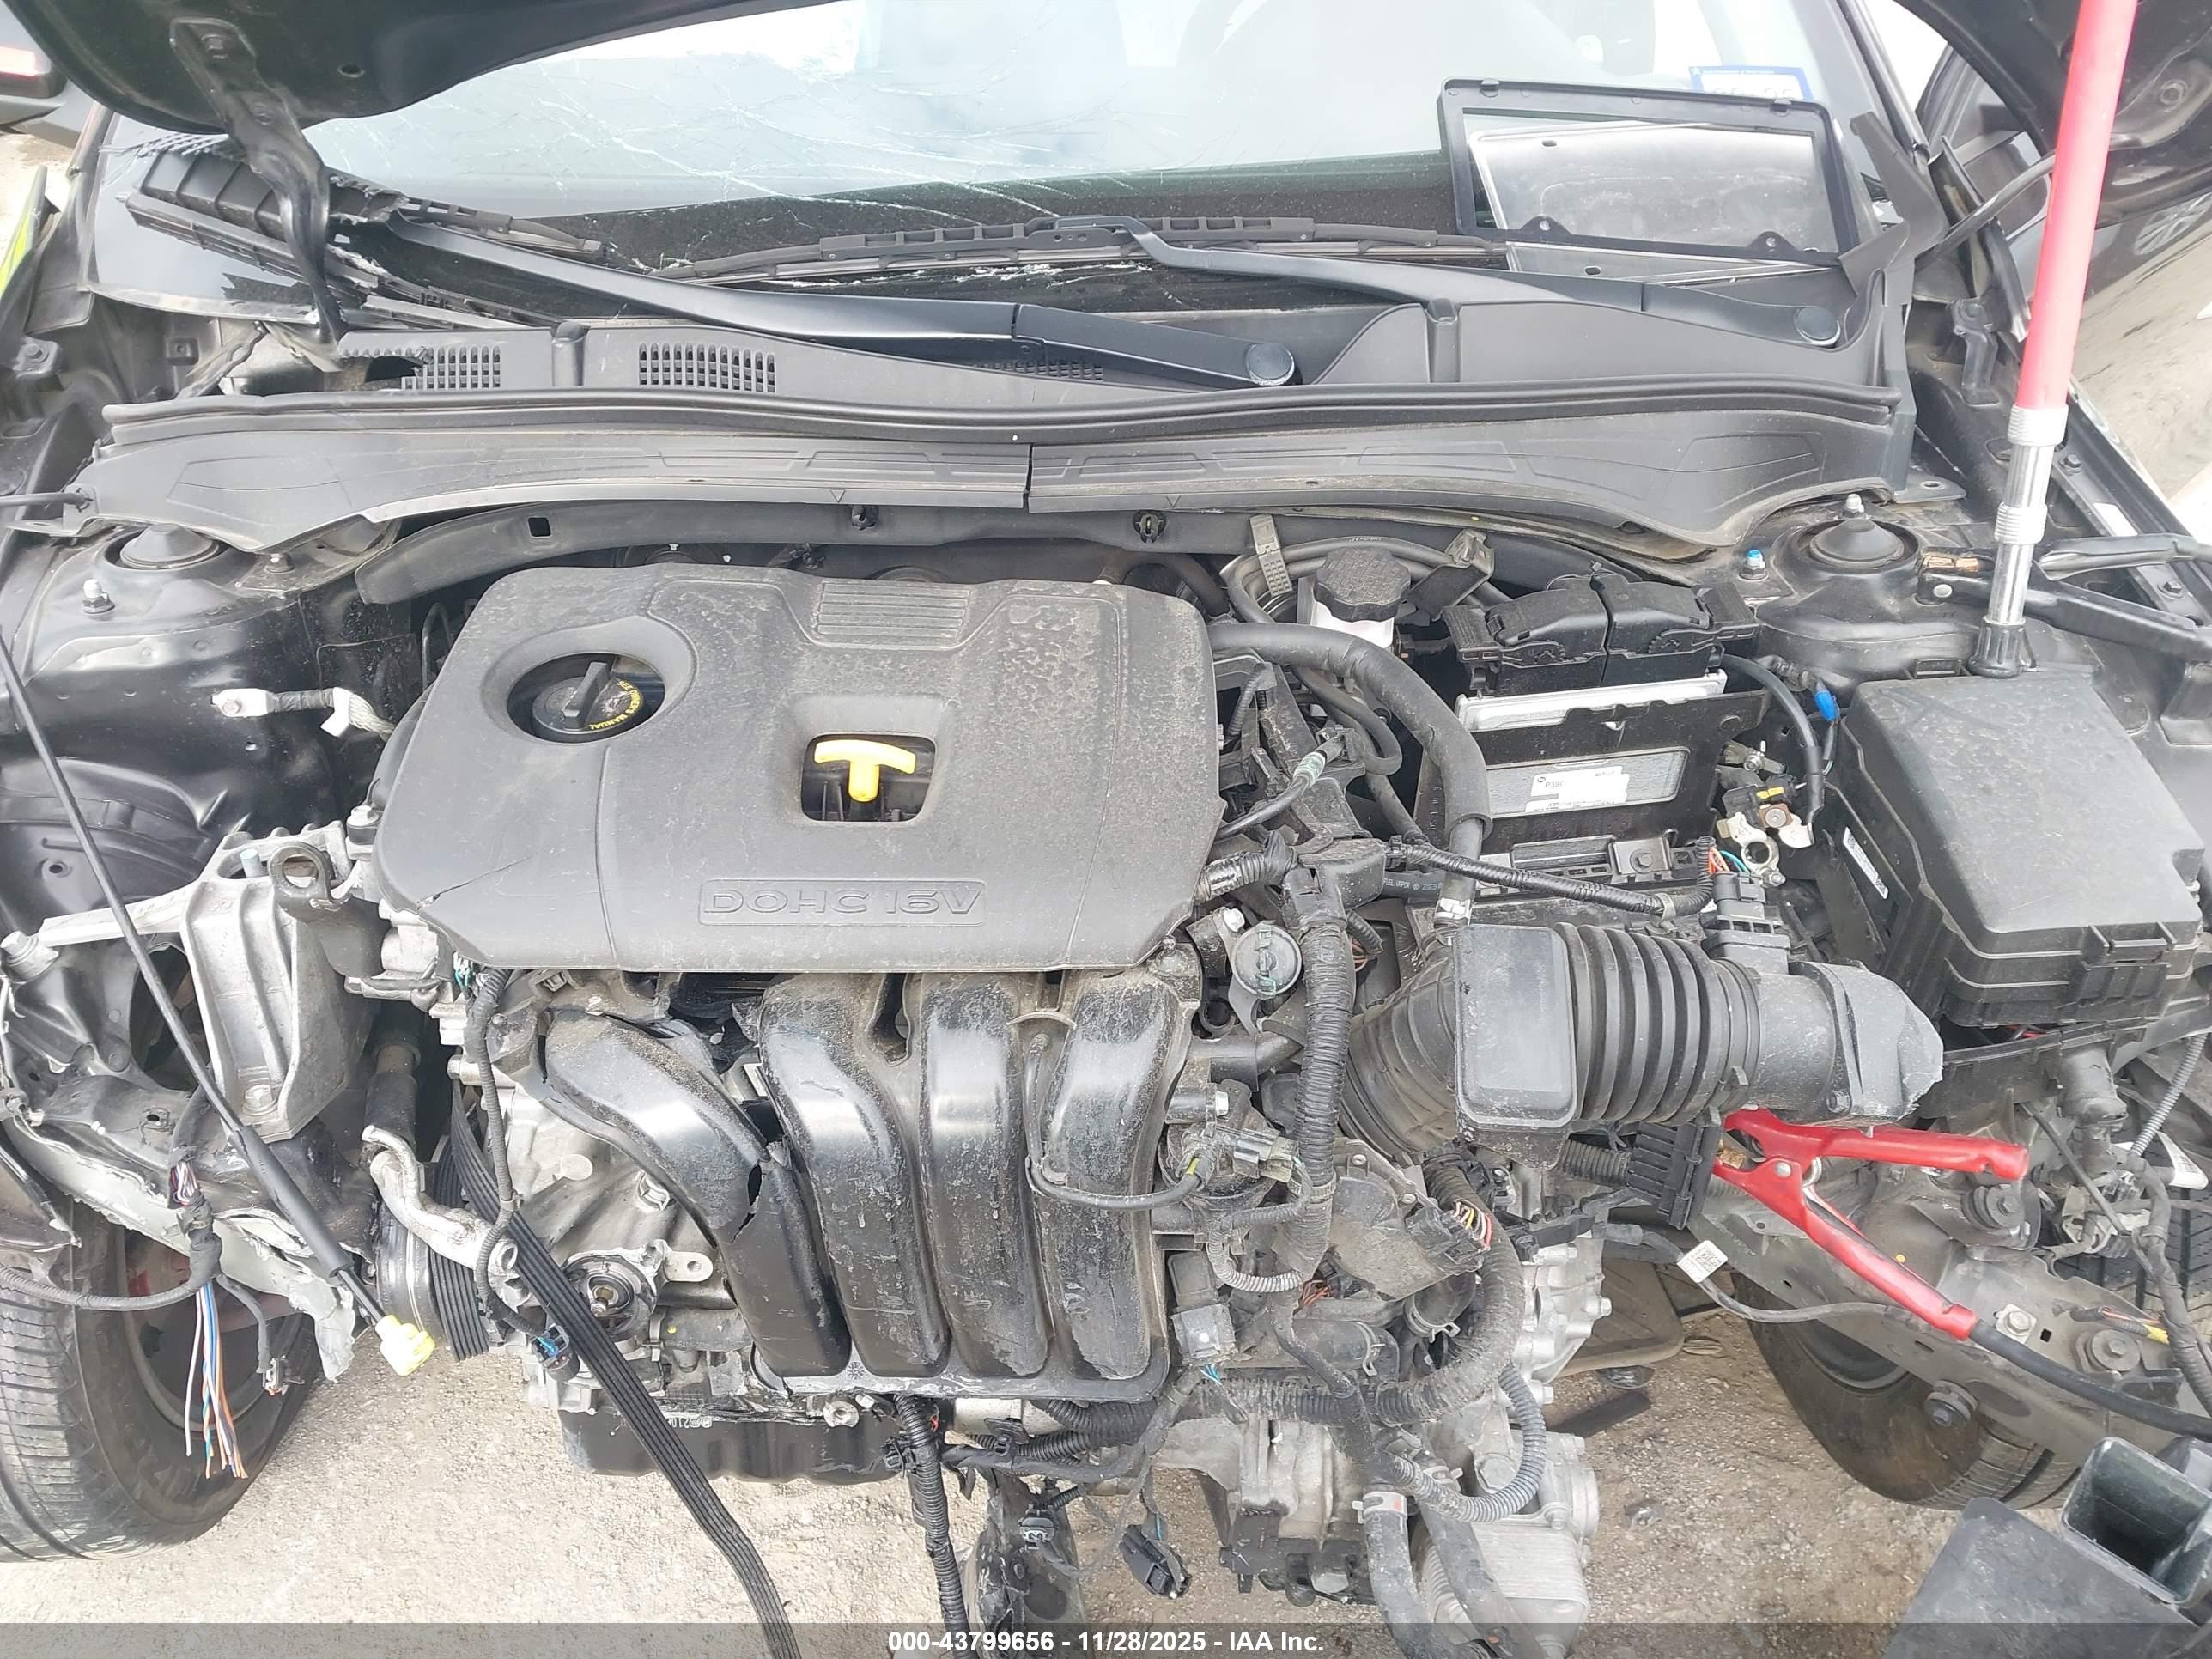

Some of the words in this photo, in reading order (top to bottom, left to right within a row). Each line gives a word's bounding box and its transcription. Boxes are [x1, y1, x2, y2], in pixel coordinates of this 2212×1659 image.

[588, 714, 628, 730] MANUAL
[703, 889, 870, 914] DOHC
[885, 890, 983, 915] 16V
